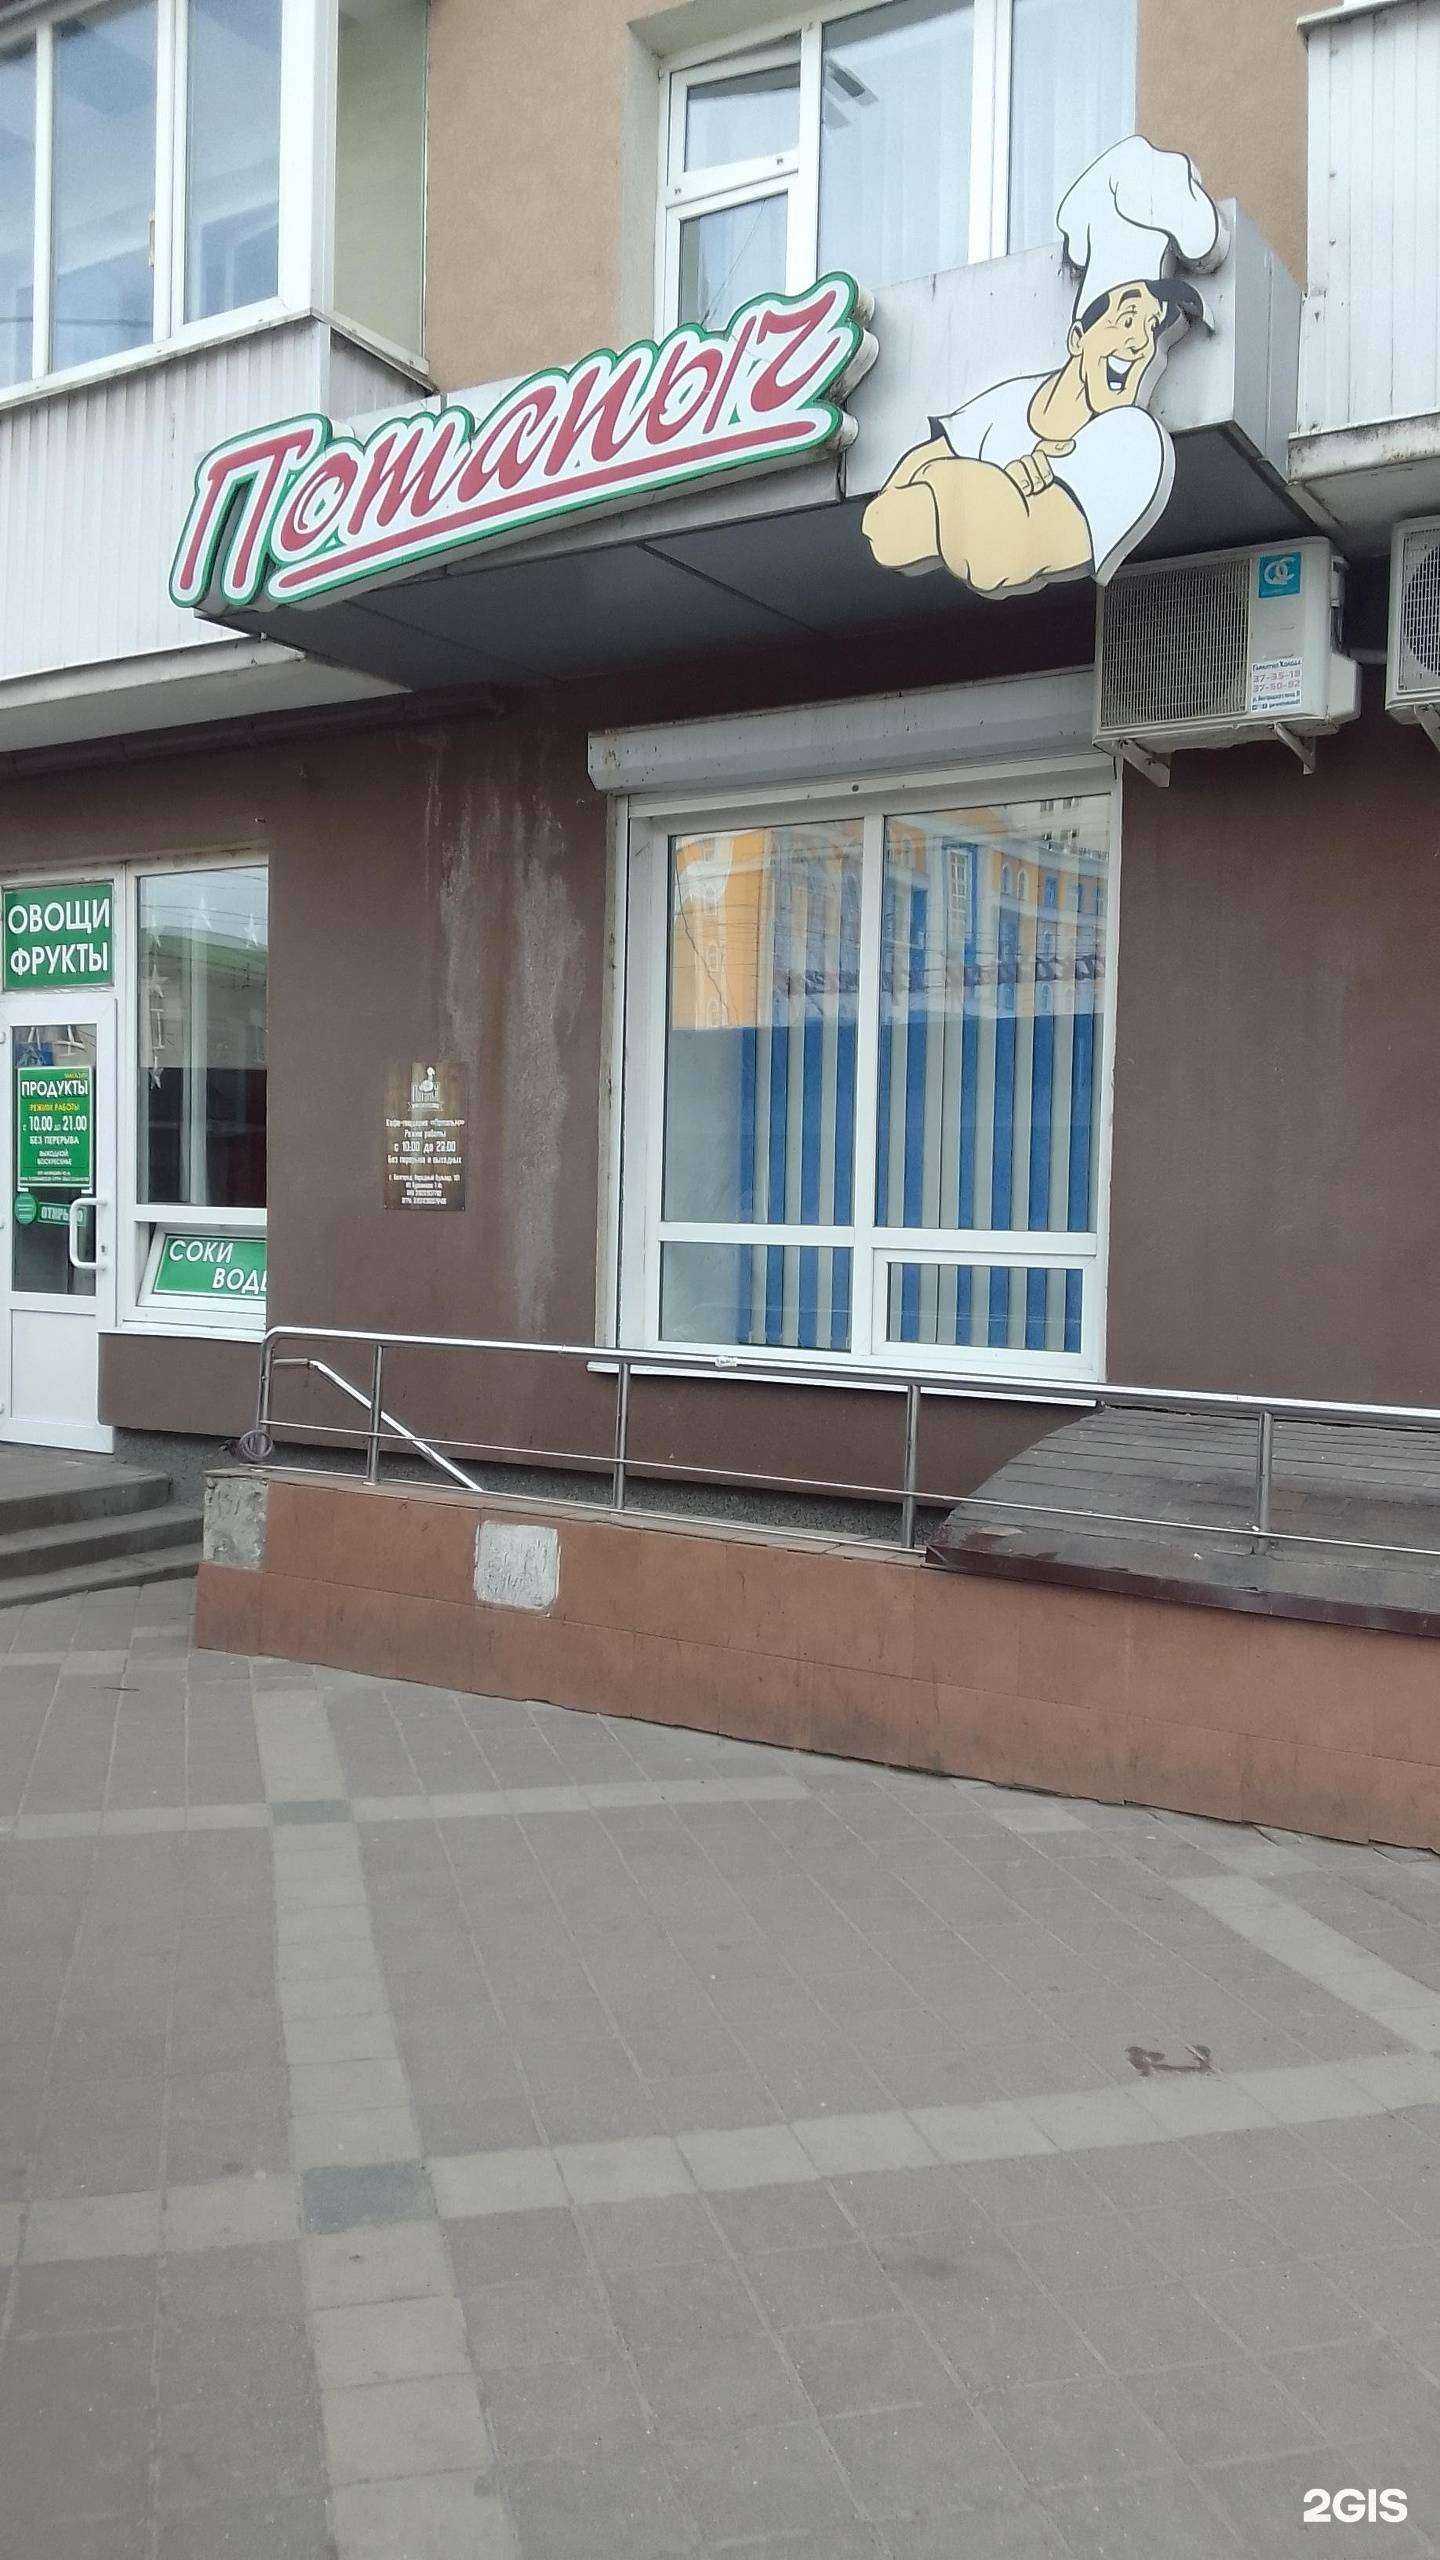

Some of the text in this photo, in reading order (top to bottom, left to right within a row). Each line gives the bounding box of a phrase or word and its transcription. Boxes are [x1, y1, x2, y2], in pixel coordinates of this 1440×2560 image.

[175, 284, 844, 593] Потапыч
[8, 898, 110, 934] ОВОЩИ
[10, 942, 108, 975] ФРУКТЫ
[21, 1080, 89, 1097] ПРОДУКТЫ
[29, 1115, 53, 1131] 10.00
[62, 1115, 88, 1131] 21.00
[169, 1239, 234, 1263] СОКИ
